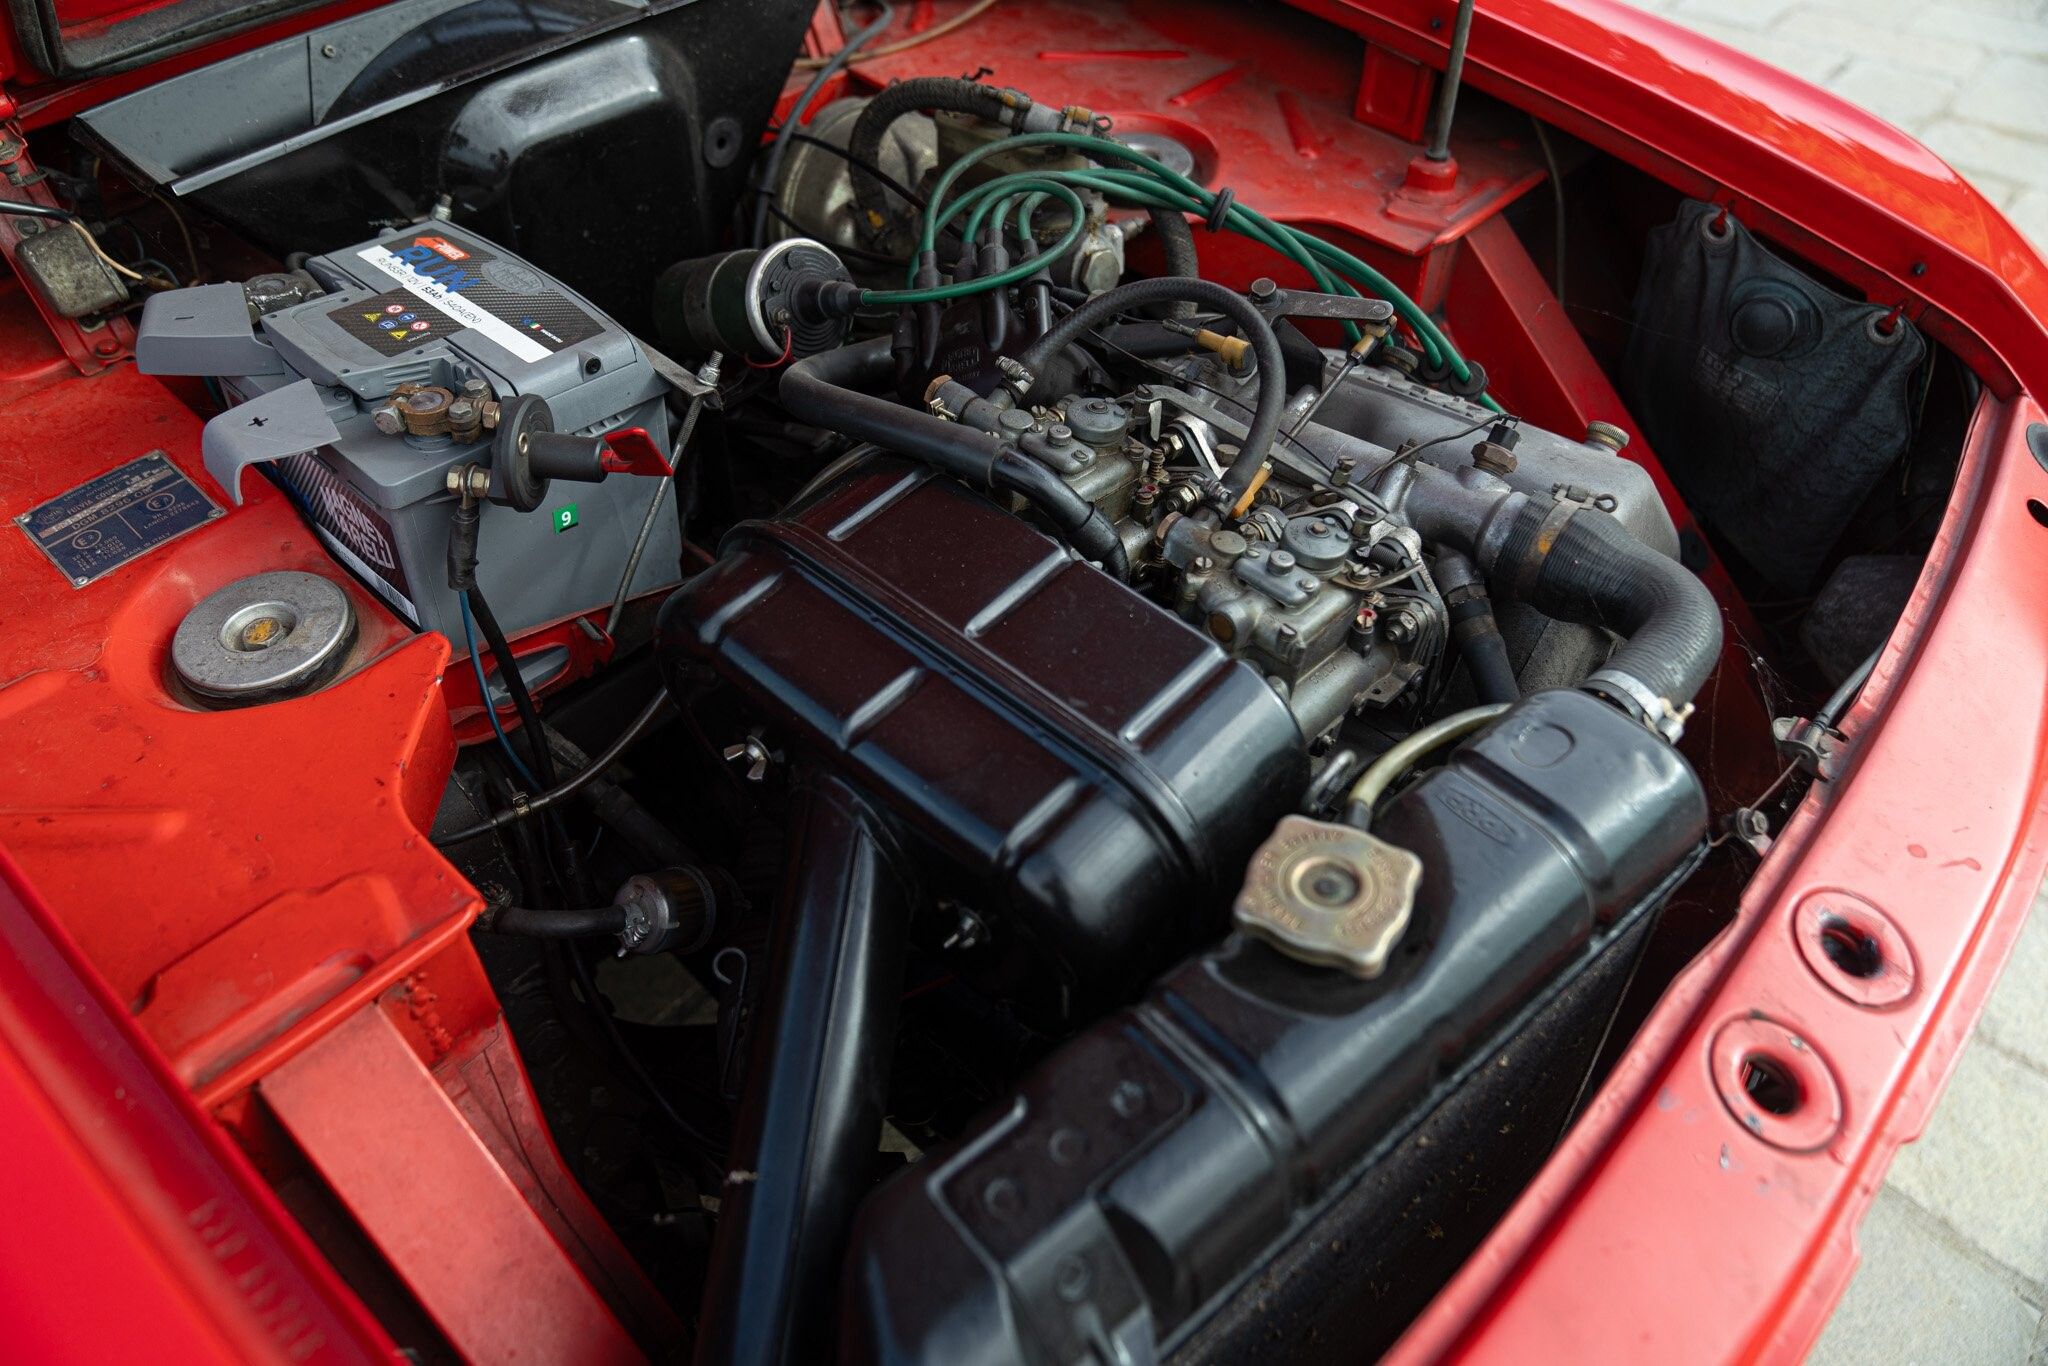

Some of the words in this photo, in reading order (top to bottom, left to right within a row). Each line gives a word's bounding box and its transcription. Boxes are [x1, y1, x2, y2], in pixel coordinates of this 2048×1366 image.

[389, 245, 480, 293] RUN
[421, 286, 442, 300] 53Ah
[70, 513, 100, 530] DGM
[99, 496, 132, 515] 8296
[561, 510, 572, 527] 9
